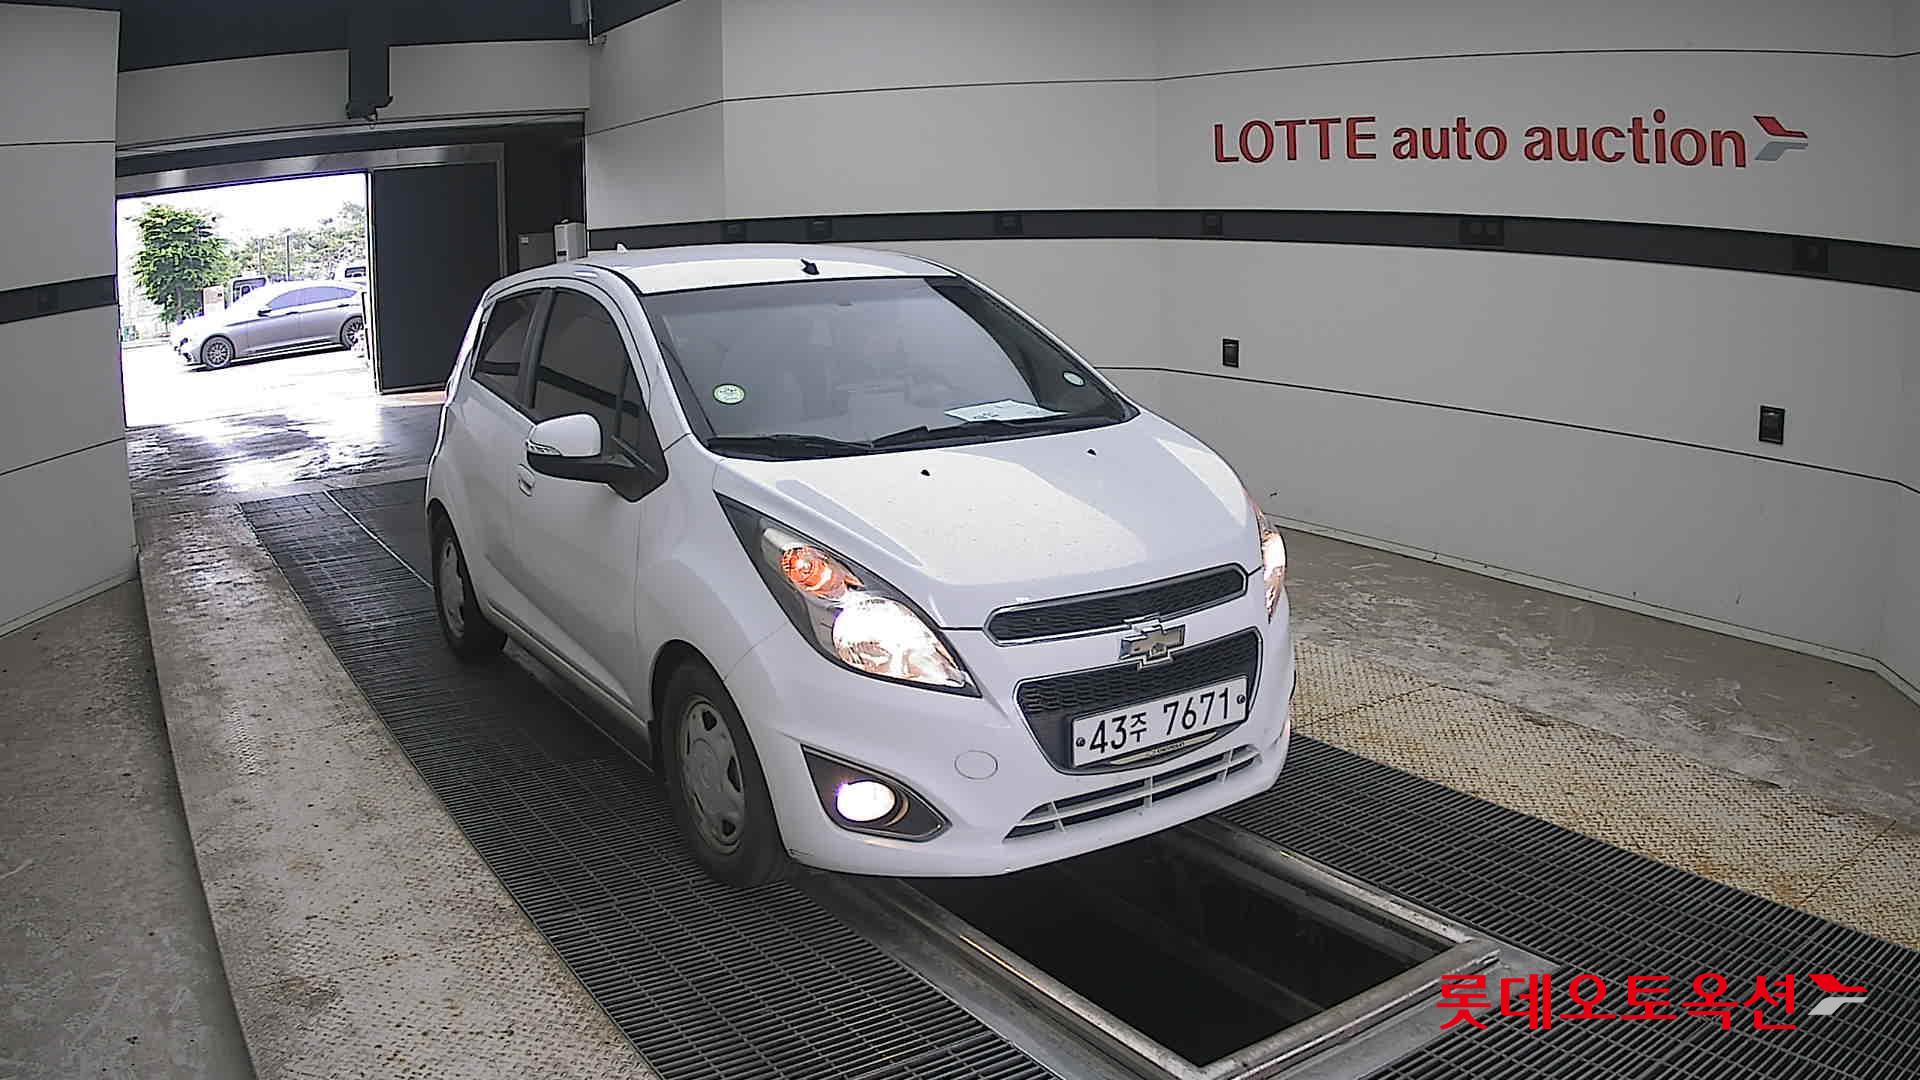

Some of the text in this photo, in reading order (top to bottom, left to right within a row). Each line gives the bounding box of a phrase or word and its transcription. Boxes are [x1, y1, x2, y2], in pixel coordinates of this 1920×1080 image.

[1213, 109, 1747, 168] LOTTE auto auction
[1089, 687, 1229, 754] 43주 7671
